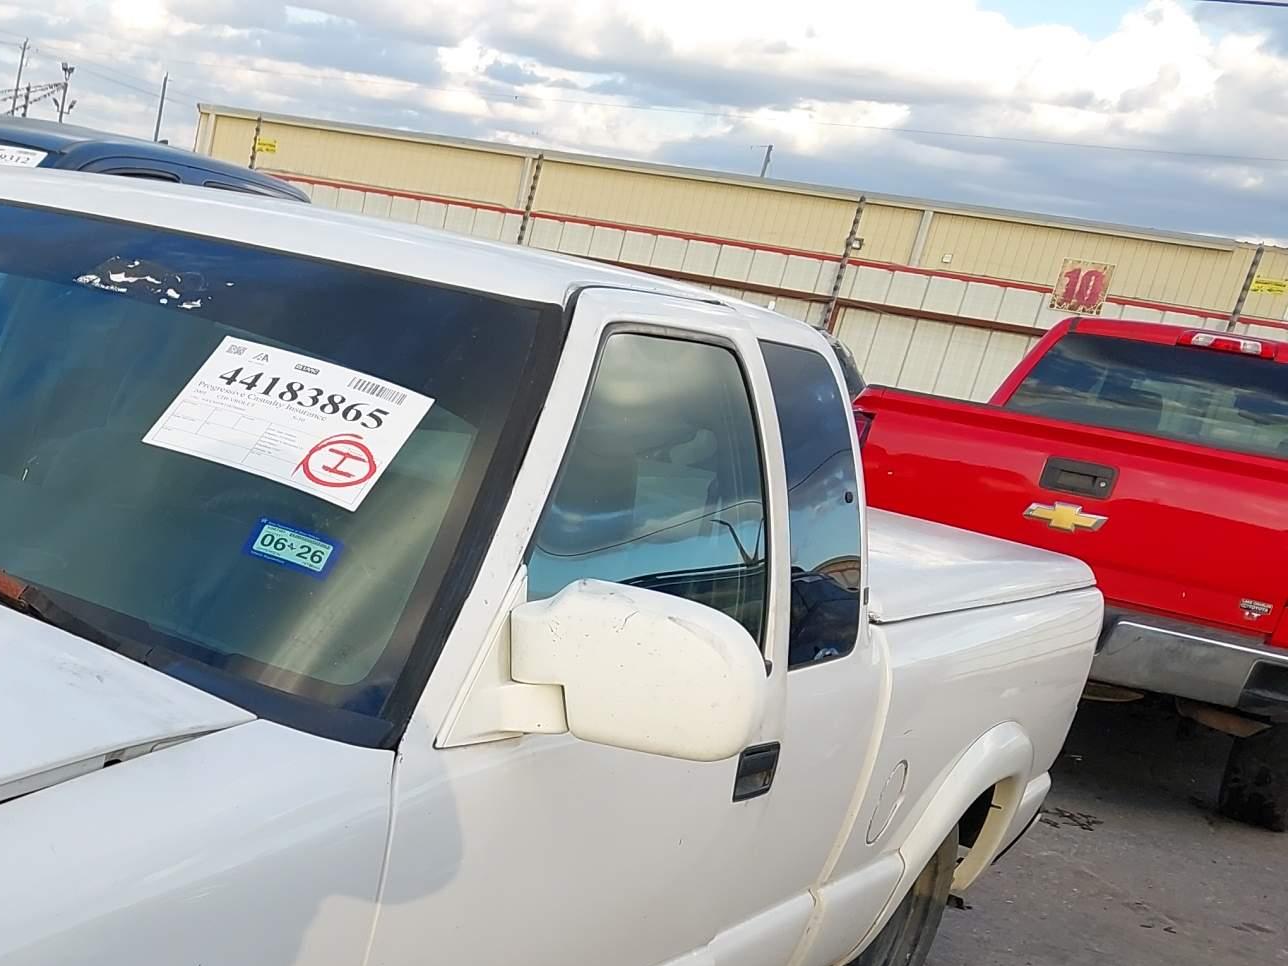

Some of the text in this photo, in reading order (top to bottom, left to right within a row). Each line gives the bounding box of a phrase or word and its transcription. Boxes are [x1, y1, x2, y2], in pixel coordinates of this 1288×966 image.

[1063, 268, 1105, 309] 10
[198, 380, 246, 397] Progressive
[247, 393, 284, 410] Casualty
[285, 403, 327, 422] Insurance
[219, 366, 390, 430] 44183865
[260, 533, 289, 551] 06
[296, 544, 325, 564] 26
